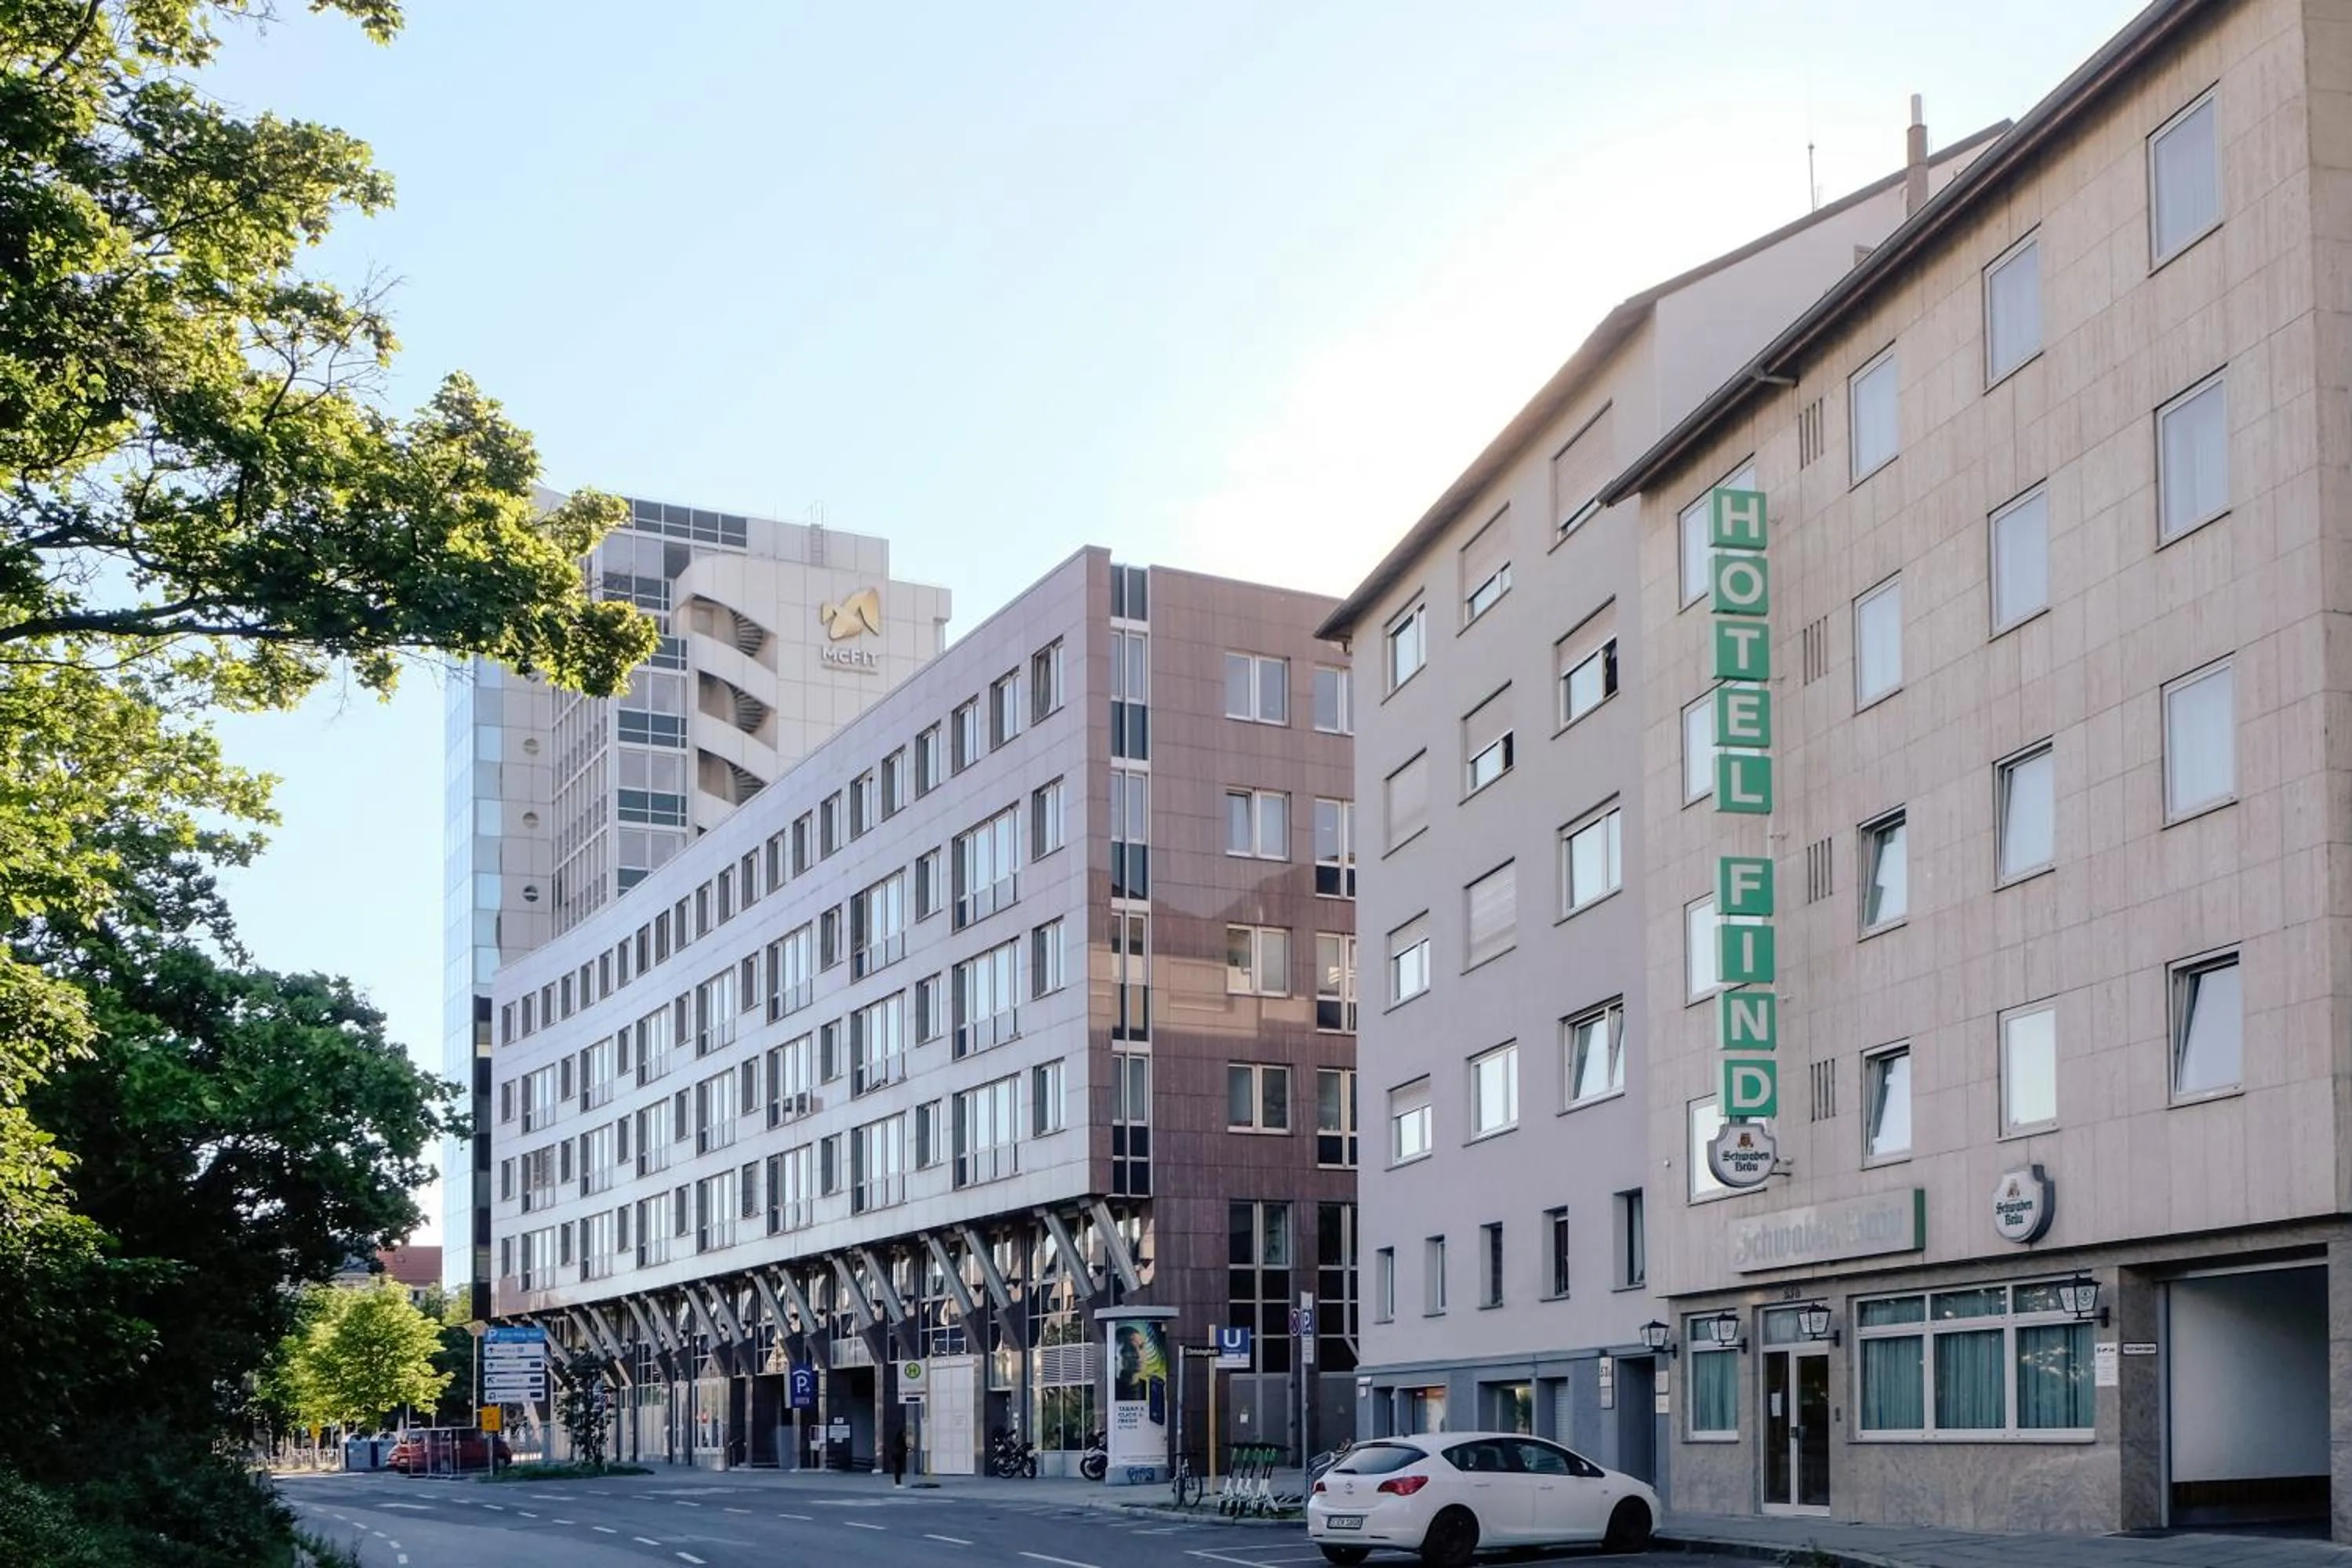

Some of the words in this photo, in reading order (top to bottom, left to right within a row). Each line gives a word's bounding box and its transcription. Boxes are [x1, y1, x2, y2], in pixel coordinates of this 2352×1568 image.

[1720, 495, 1763, 803] HOTEL
[1730, 864, 1772, 1109] FIND
[1722, 1151, 1769, 1161] Schwaben
[1735, 1162, 1758, 1171] Bräu
[1995, 1200, 2033, 1214] Schwaben
[2005, 1213, 2023, 1225] Bräu
[1224, 1329, 1240, 1348] U
[797, 1376, 808, 1393] P
